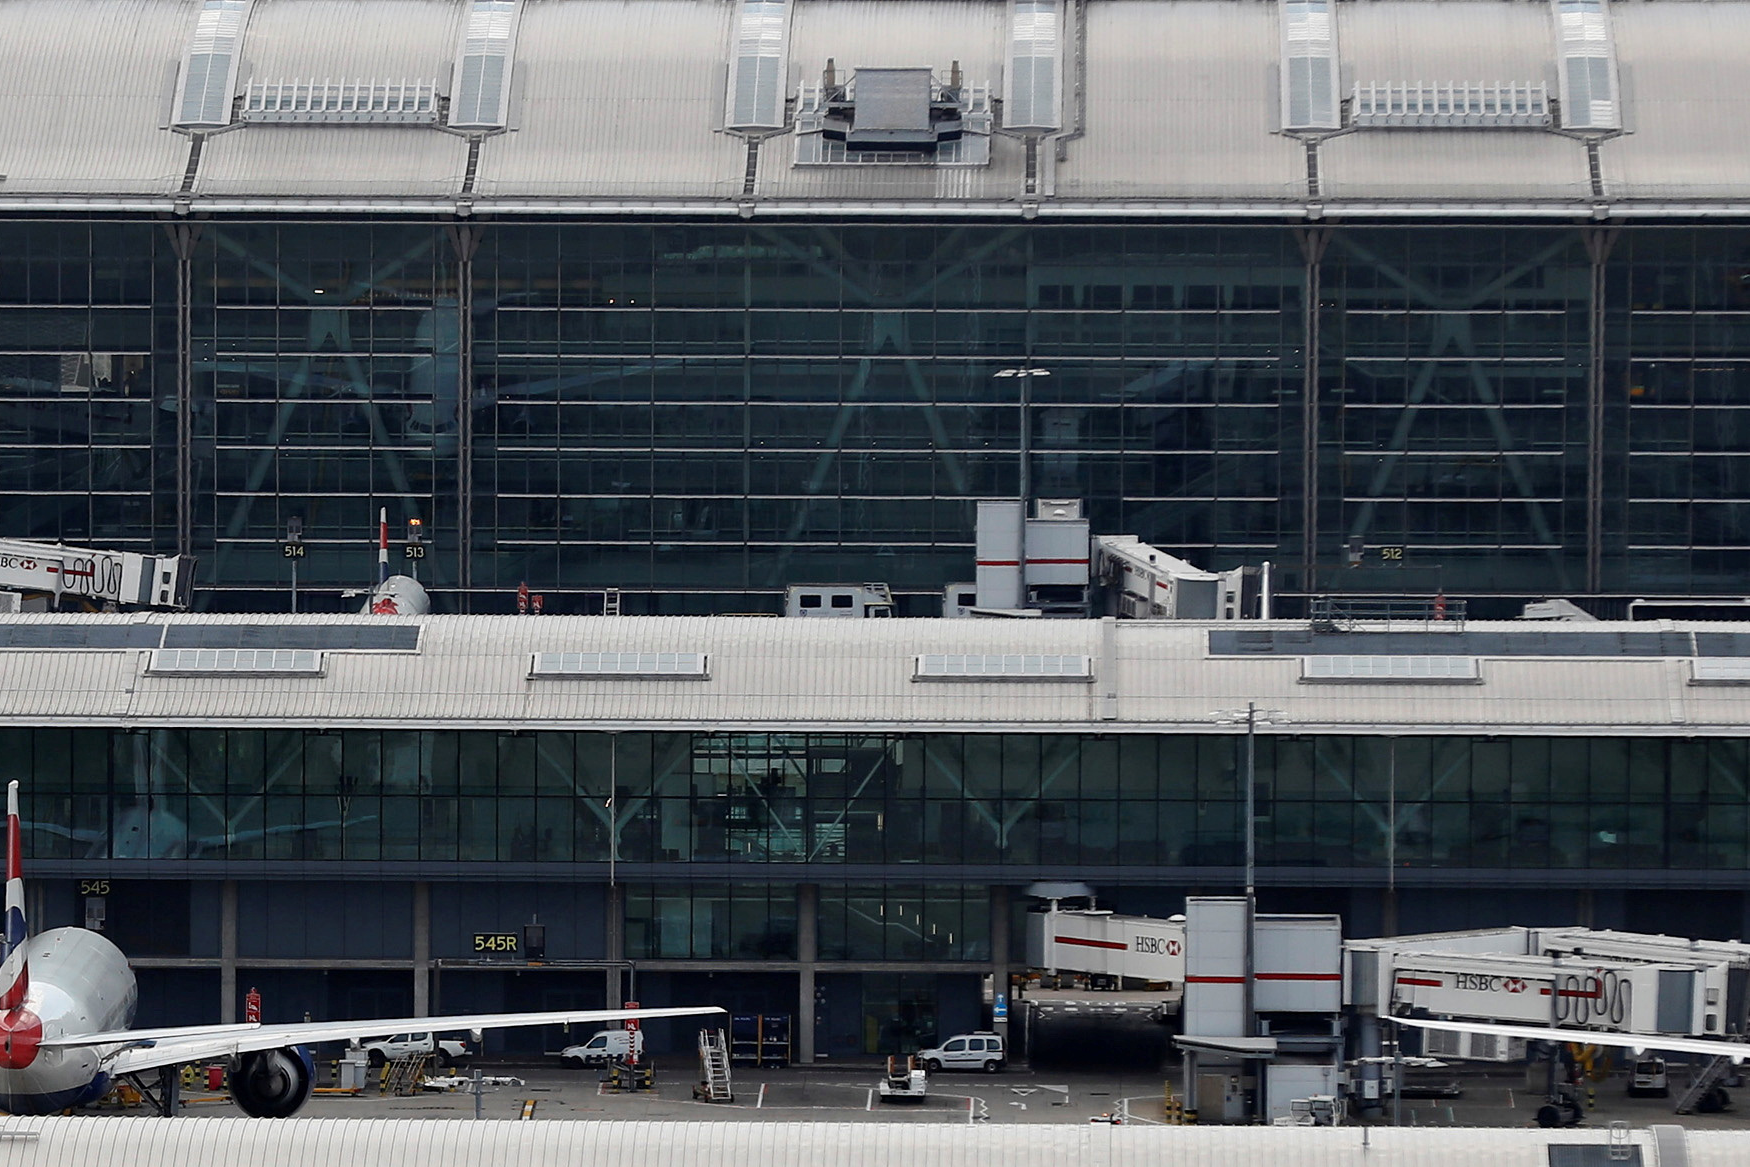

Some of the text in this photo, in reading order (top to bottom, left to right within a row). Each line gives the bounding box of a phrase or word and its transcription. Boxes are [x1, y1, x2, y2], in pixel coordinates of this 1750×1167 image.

[284, 545, 305, 557] 514
[405, 546, 425, 558] 513
[1382, 548, 1403, 560] 512
[81, 880, 110, 895] 545
[474, 936, 517, 951] 545R
[1135, 935, 1166, 954] HSBC
[1455, 974, 1501, 992] HSBC
